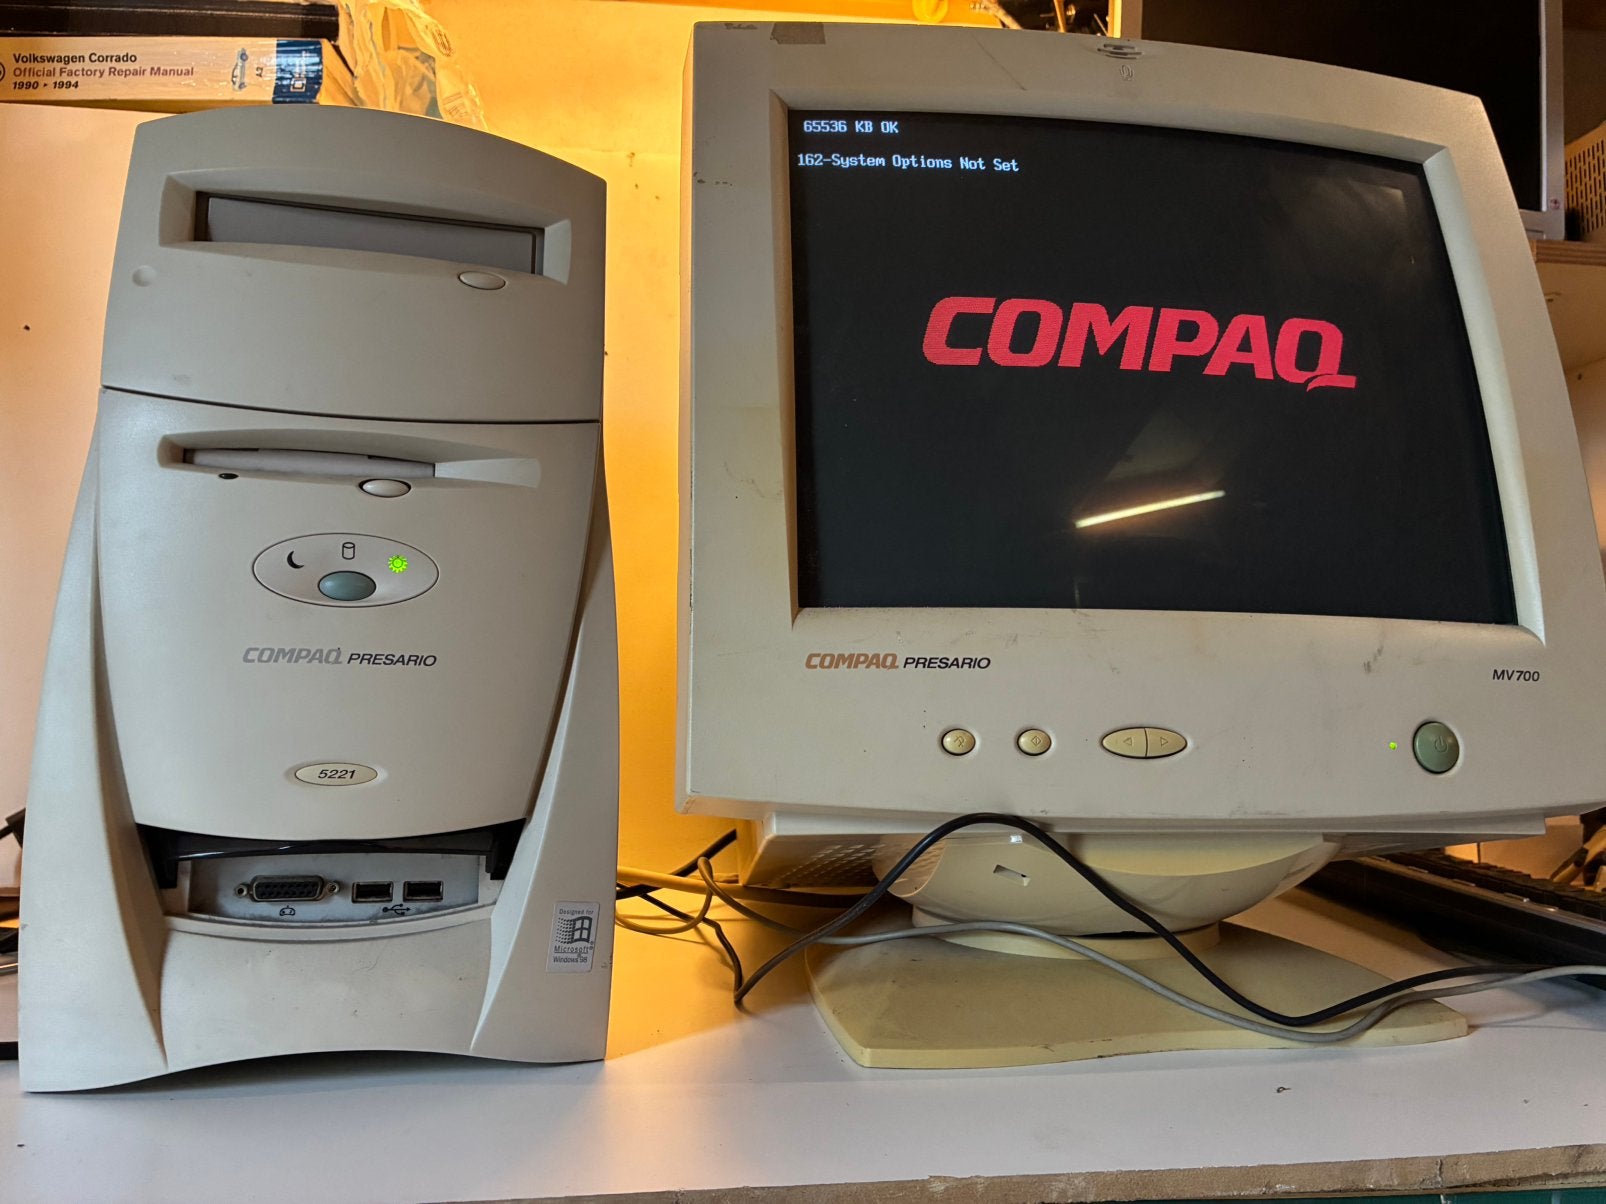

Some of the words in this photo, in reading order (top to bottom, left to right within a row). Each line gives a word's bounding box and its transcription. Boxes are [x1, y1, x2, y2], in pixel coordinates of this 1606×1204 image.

[13, 52, 85, 65] Volkswagen
[88, 52, 137, 64] Corrado
[13, 67, 56, 78] Official
[59, 67, 105, 79] Factory
[109, 66, 147, 79] Repair
[150, 66, 194, 77] Manual
[12, 81, 39, 90] 1990
[52, 81, 79, 89] 1994
[803, 120, 847, 133] 65536
[855, 121, 873, 133] KB
[881, 121, 899, 134] OK
[797, 154, 886, 168] 162-System
[892, 155, 952, 169] Options
[959, 157, 986, 170] Not
[993, 159, 1019, 172] Set
[922, 296, 1357, 392] COMPAQ
[242, 647, 343, 665] COMPAQ
[347, 653, 437, 667] PRESARIO
[805, 653, 899, 670] COMPAQ
[903, 657, 991, 669] PRESARIO
[1492, 669, 1540, 681] MV700
[318, 769, 356, 779] 5221
[559, 908, 585, 916] Designed
